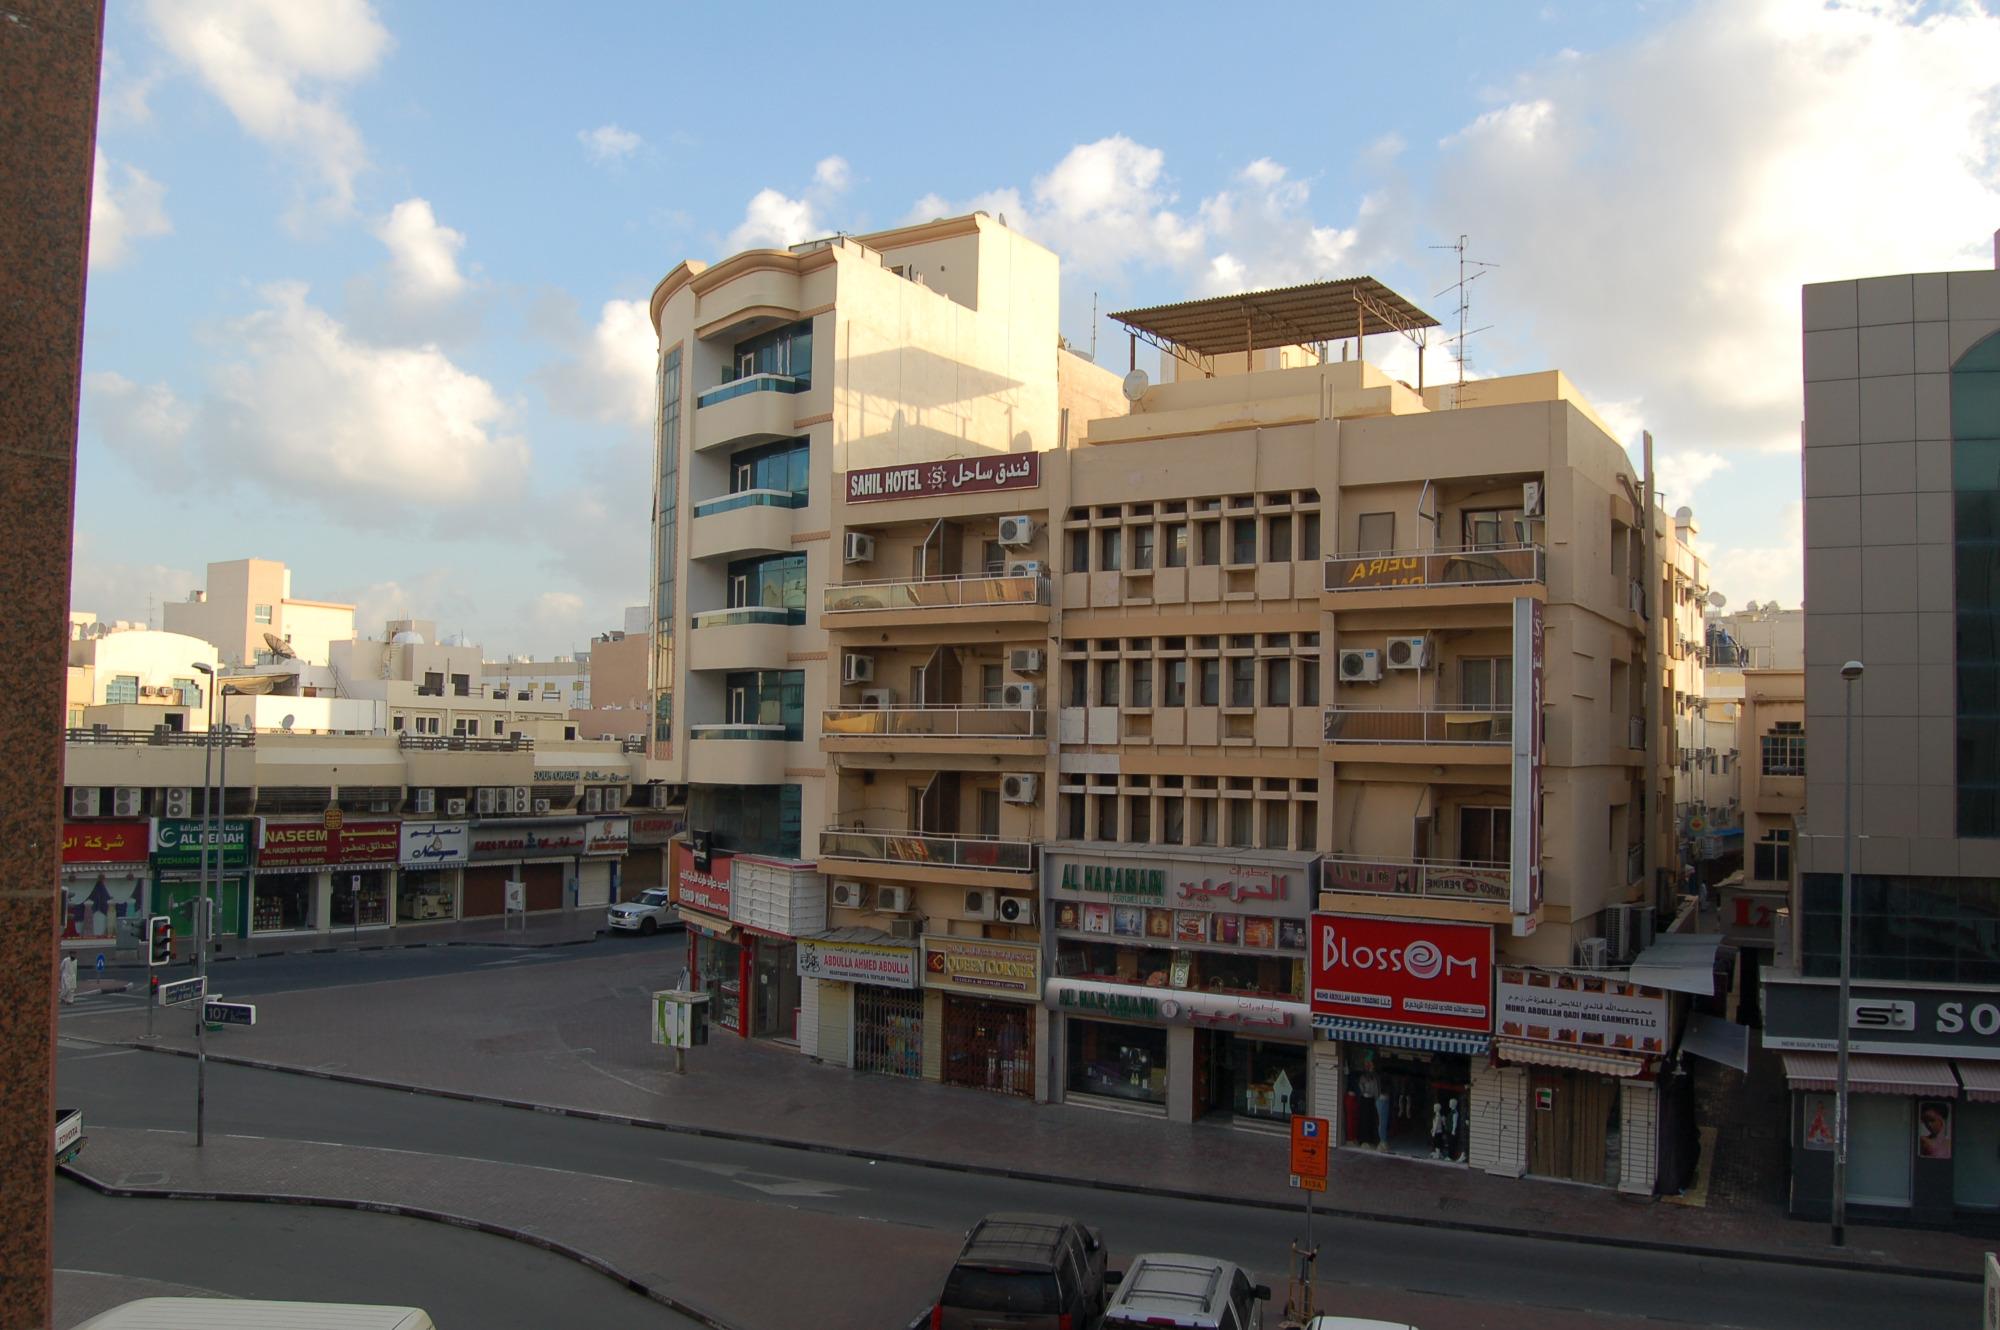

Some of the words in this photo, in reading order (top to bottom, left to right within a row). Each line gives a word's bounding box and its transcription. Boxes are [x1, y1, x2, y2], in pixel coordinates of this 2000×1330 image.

[952, 461, 993, 487] ساحل
[995, 456, 1030, 484] فندق
[851, 473, 883, 497] SAHIL
[885, 469, 922, 494] HOTEL
[84, 833, 126, 851] شركة
[181, 833, 196, 843] AL
[265, 830, 328, 843] NASEEM
[1061, 863, 1081, 891] AL
[1084, 864, 1167, 898] HARAMAIN
[1176, 873, 1288, 905] الحرمين
[824, 955, 853, 969] ABDULLA
[854, 958, 877, 971] AHMED
[878, 960, 909, 976] ABDULLA
[947, 956, 986, 974] QUEEN
[986, 960, 1035, 978] CORNER
[1059, 988, 1075, 1006] AL
[208, 1007, 229, 1020] 107
[1528, 1006, 1562, 1018] ABDULLAH
[1581, 1012, 1601, 1022] MADE
[1601, 1014, 1640, 1026] GARMENTS
[1936, 1002, 2000, 1035] SO
